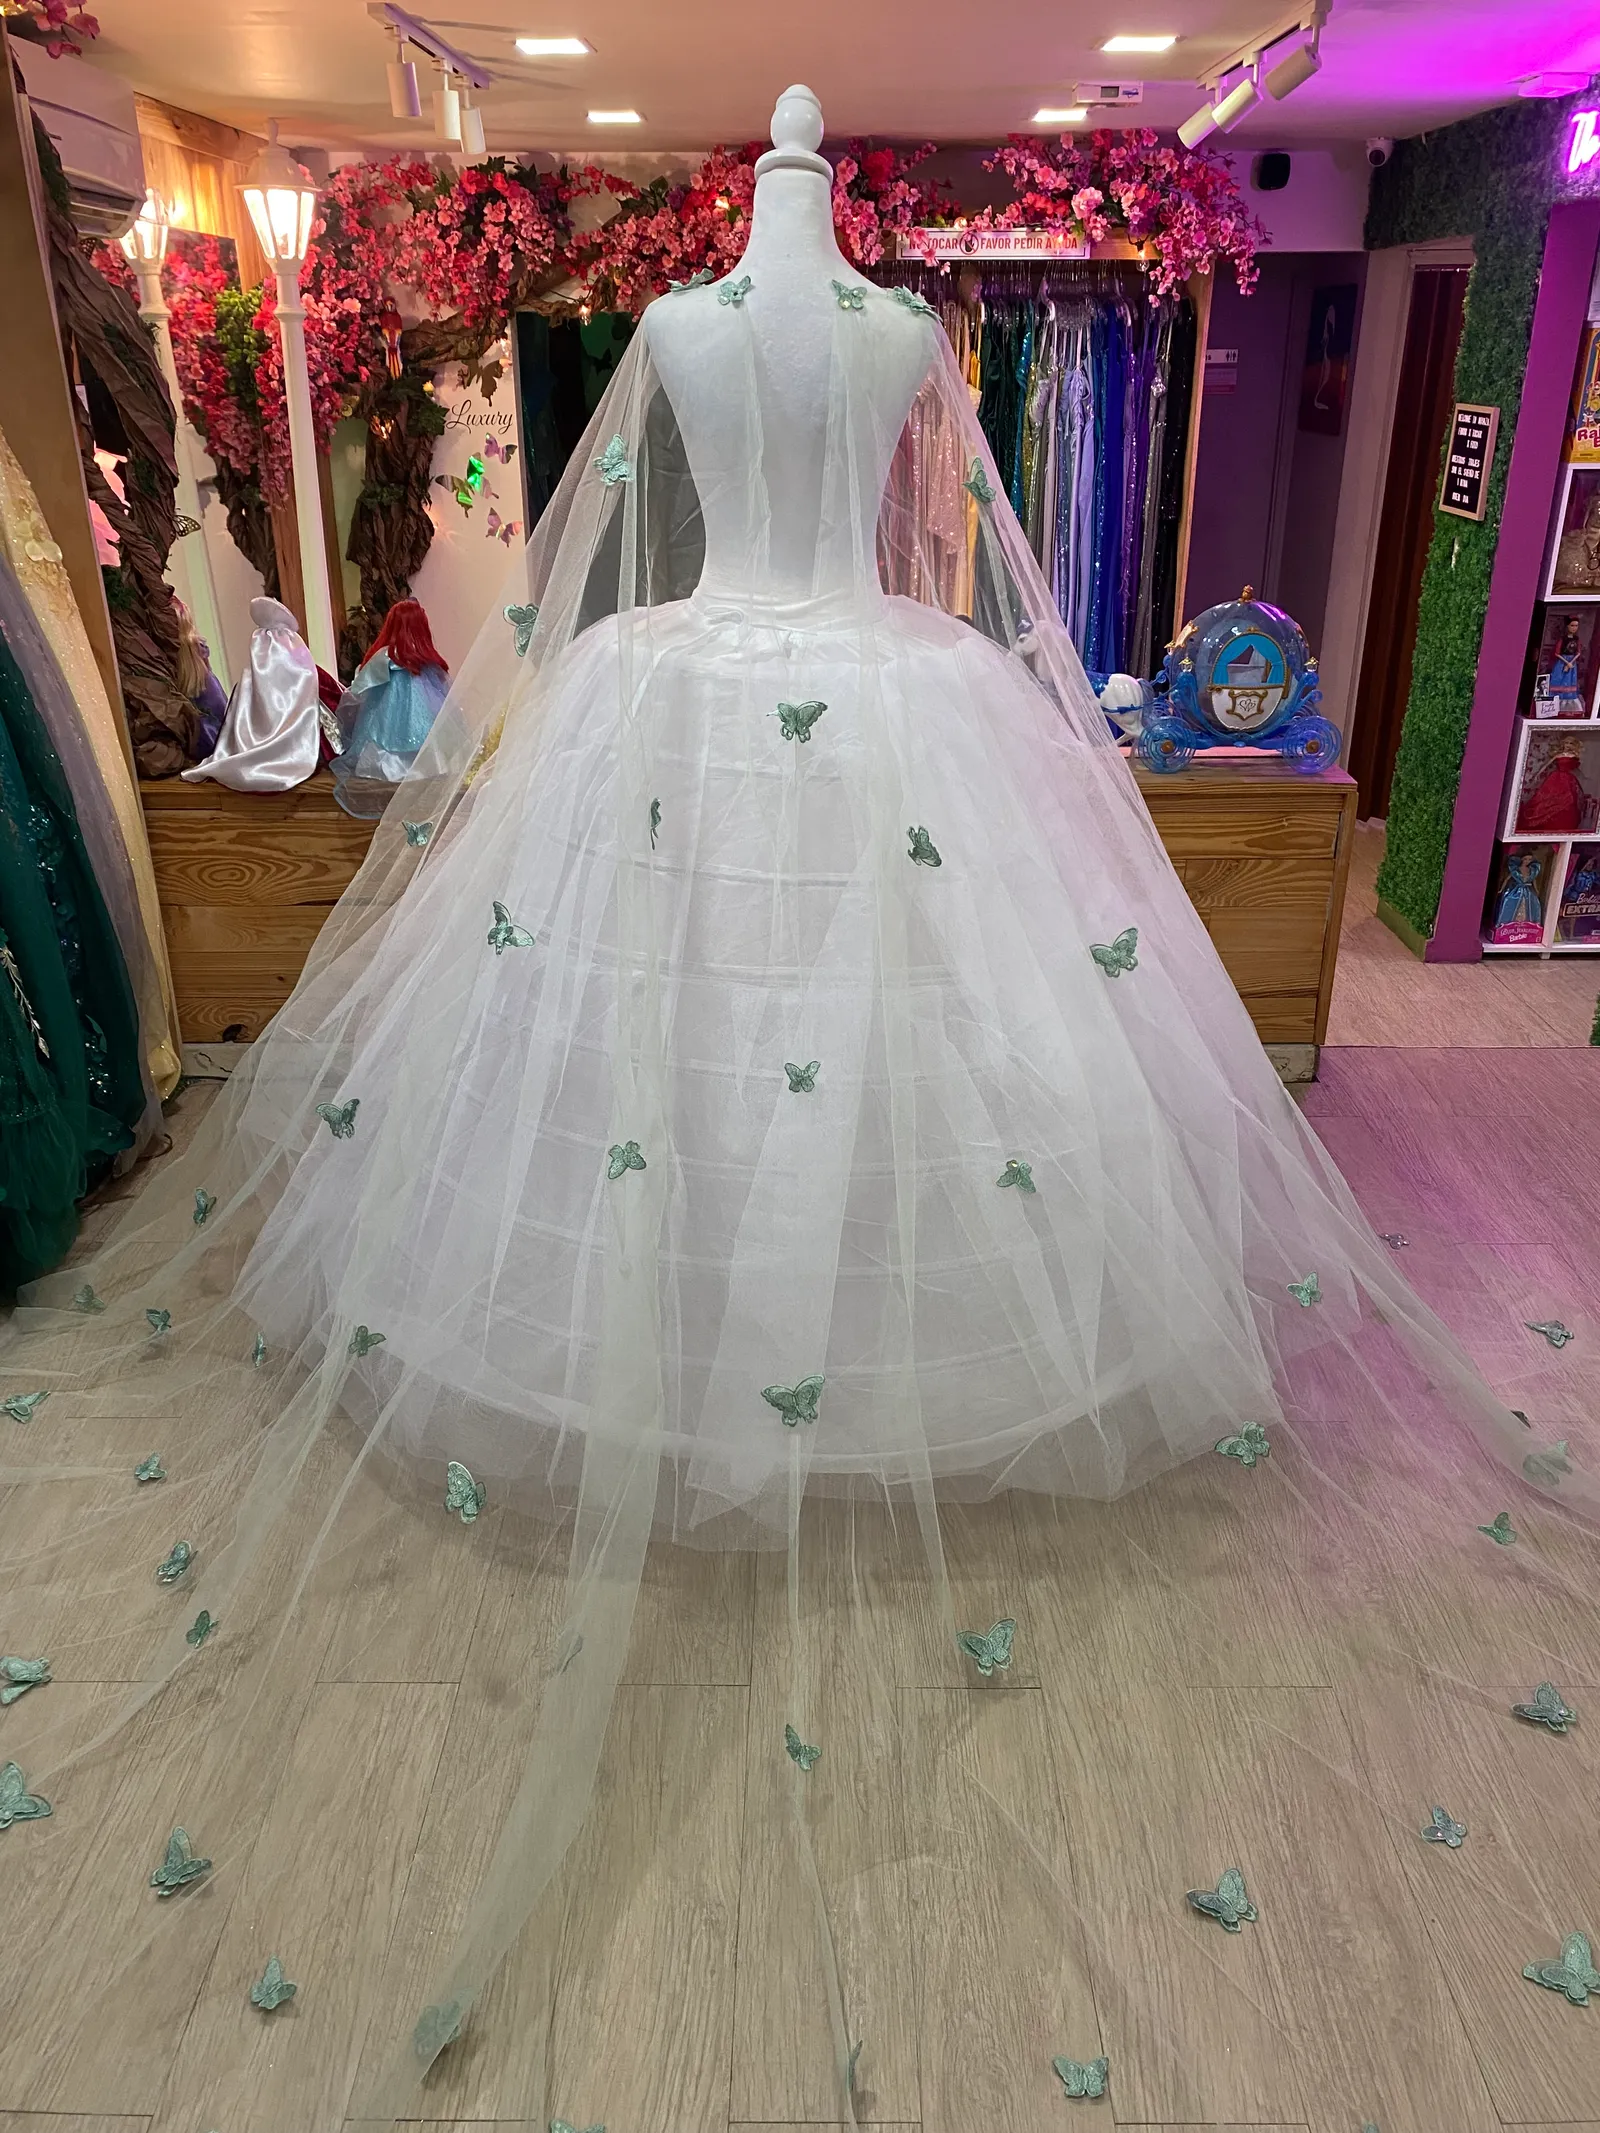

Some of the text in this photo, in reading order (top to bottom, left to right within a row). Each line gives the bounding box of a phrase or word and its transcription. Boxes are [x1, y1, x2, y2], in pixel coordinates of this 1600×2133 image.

[980, 237, 1011, 249] FAVOR
[1013, 237, 1043, 249] PEDIR
[445, 399, 513, 435] Luxury
[1577, 428, 1600, 442] Ra
[1509, 933, 1528, 943] Barbie
